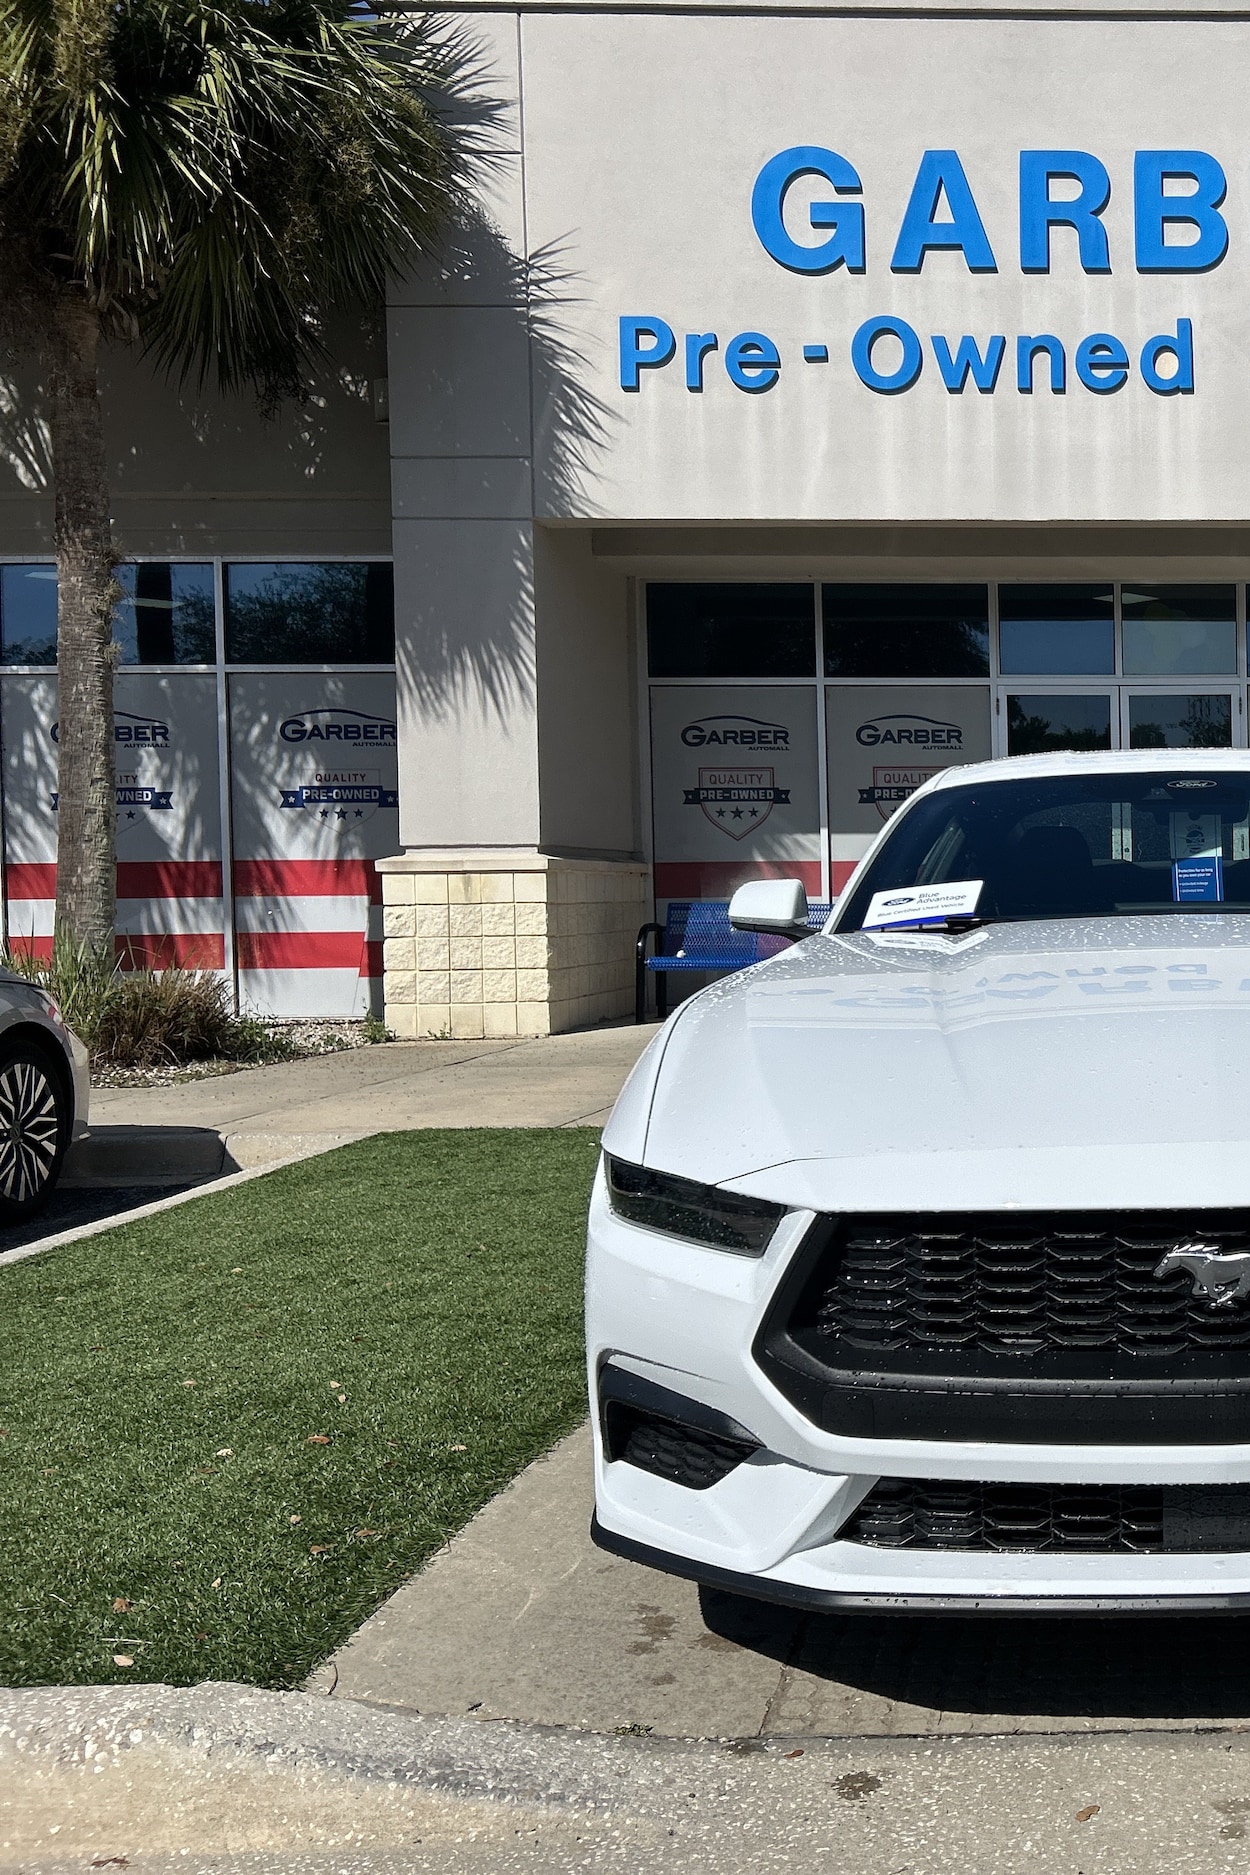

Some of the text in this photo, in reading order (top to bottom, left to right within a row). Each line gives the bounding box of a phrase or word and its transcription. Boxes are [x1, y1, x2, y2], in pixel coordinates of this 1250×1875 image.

[619, 315, 1193, 394] Pre-Owned
[280, 719, 396, 743] GARBER
[681, 725, 790, 747] GARBER
[856, 724, 963, 746] GARBER
[315, 773, 366, 782] QUALITY
[709, 774, 763, 785] QUALITY
[302, 789, 380, 800] PRE-OWNED
[700, 789, 774, 800] PRE-OWNED
[916, 894, 967, 905] Advantage
[918, 891, 940, 900] Blue
